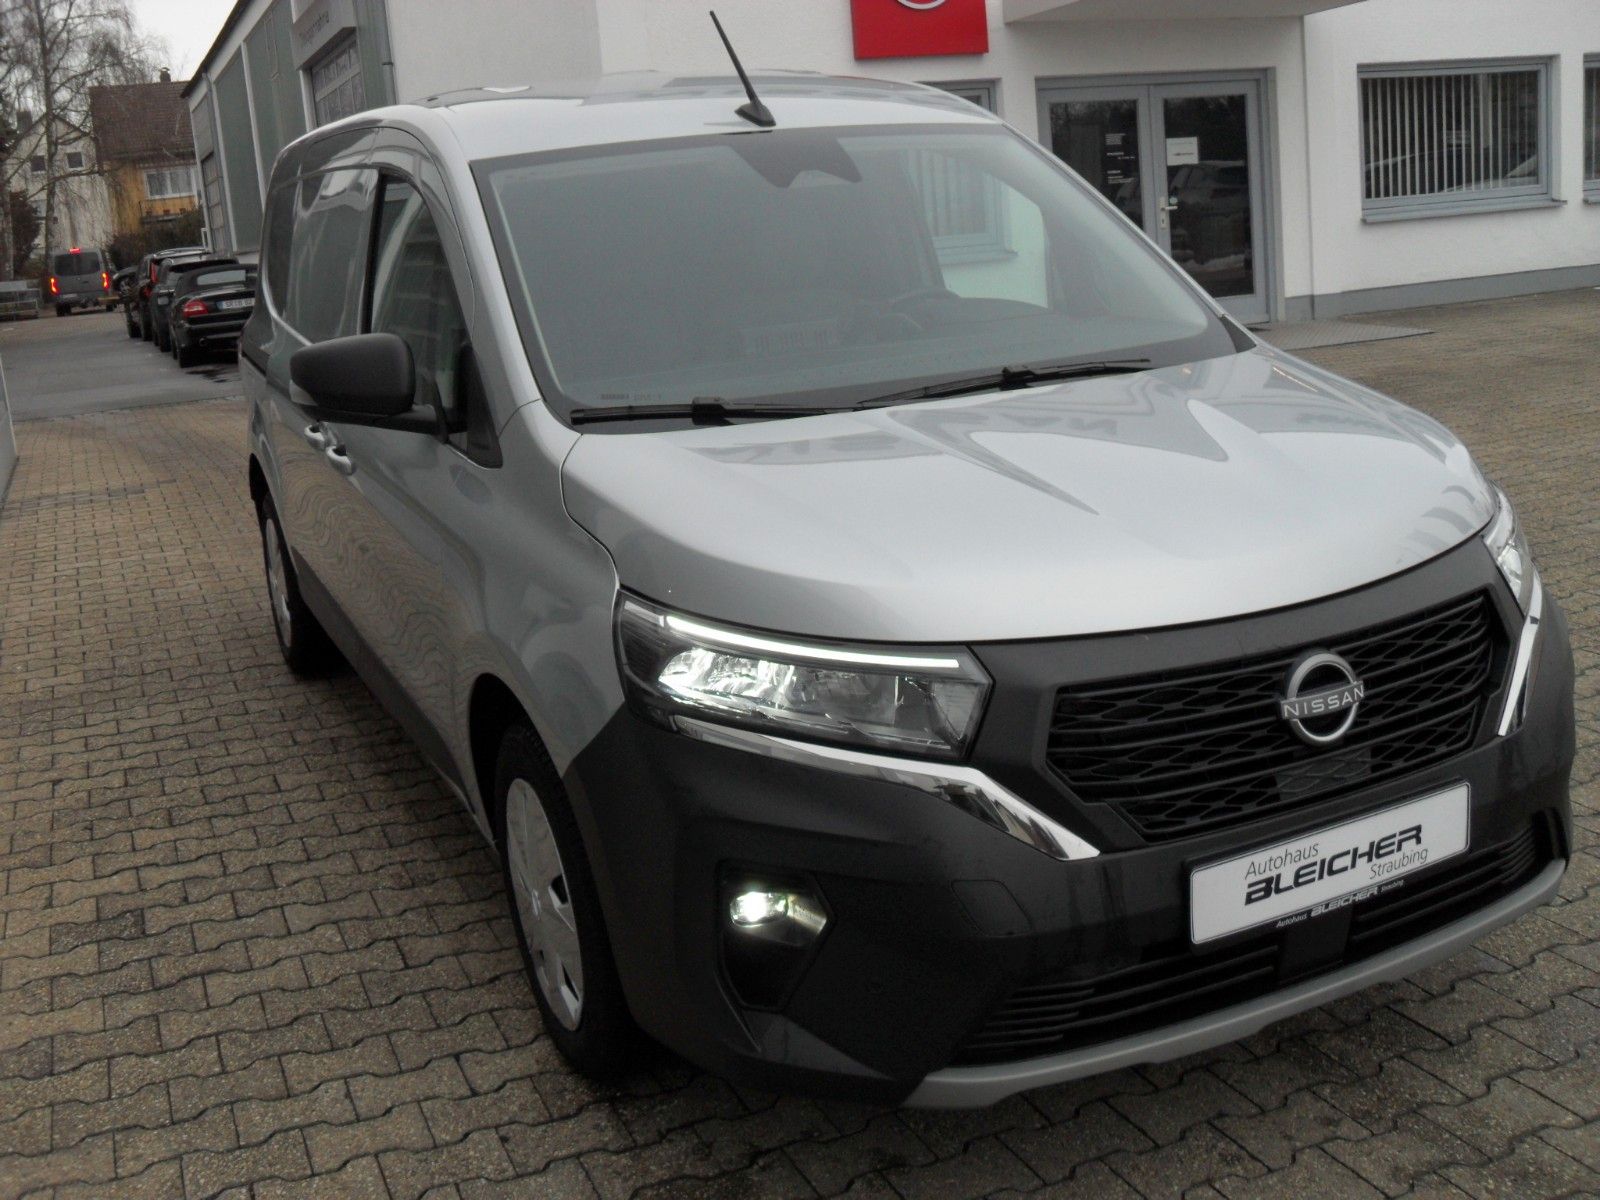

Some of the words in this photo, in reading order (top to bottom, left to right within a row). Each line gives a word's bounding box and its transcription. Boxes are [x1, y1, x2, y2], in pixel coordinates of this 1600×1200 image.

[1283, 684, 1364, 717] NISSAN
[1244, 824, 1422, 906] BLEICHER
[1245, 843, 1319, 880] Autohaus
[1369, 848, 1428, 880] Straubing
[1310, 887, 1378, 917] BLEICHER
